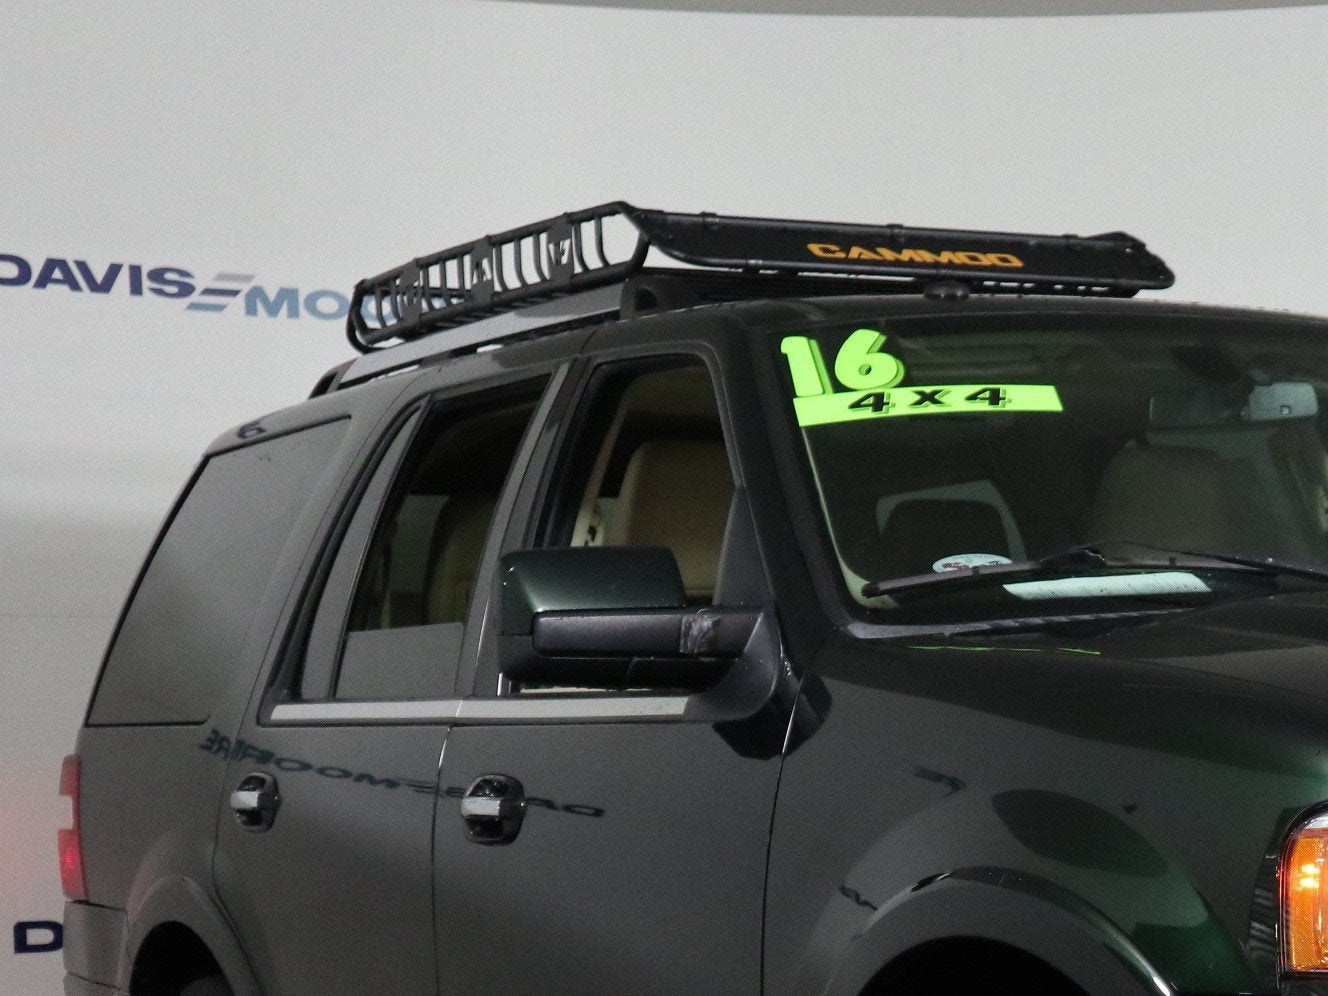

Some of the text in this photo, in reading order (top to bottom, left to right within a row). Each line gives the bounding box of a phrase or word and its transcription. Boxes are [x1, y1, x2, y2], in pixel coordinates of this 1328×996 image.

[0, 253, 197, 300] DAVIS
[806, 242, 1024, 268] CAMMOD
[780, 328, 905, 398] 16
